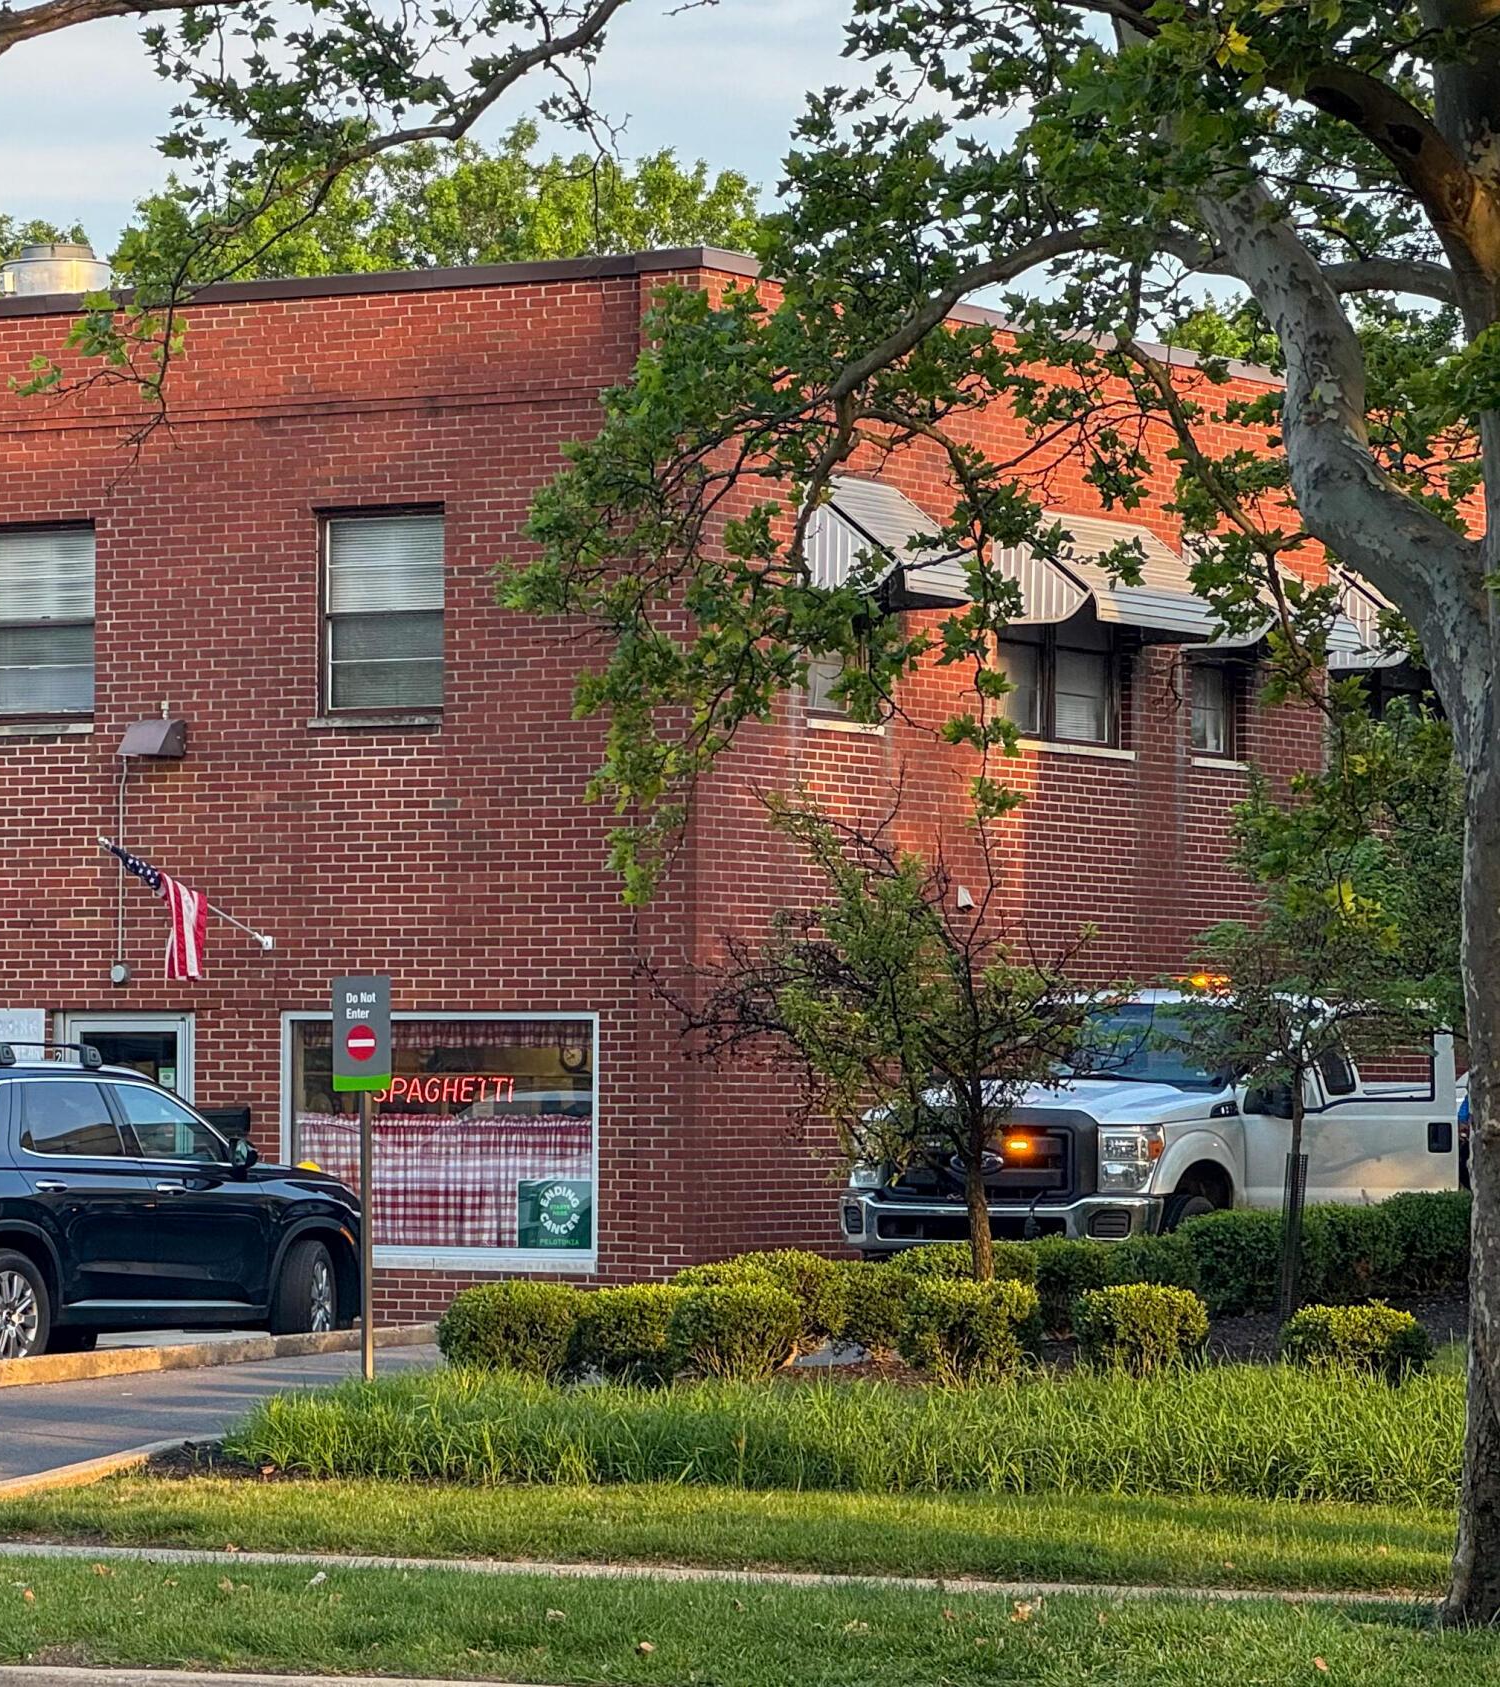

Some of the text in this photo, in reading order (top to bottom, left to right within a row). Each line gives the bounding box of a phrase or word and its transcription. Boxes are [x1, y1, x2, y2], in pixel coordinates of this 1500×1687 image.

[346, 992, 376, 1003] Do Not
[346, 1007, 370, 1019] Enter
[540, 1186, 580, 1208] ENDING
[540, 1213, 580, 1234] CANCER
